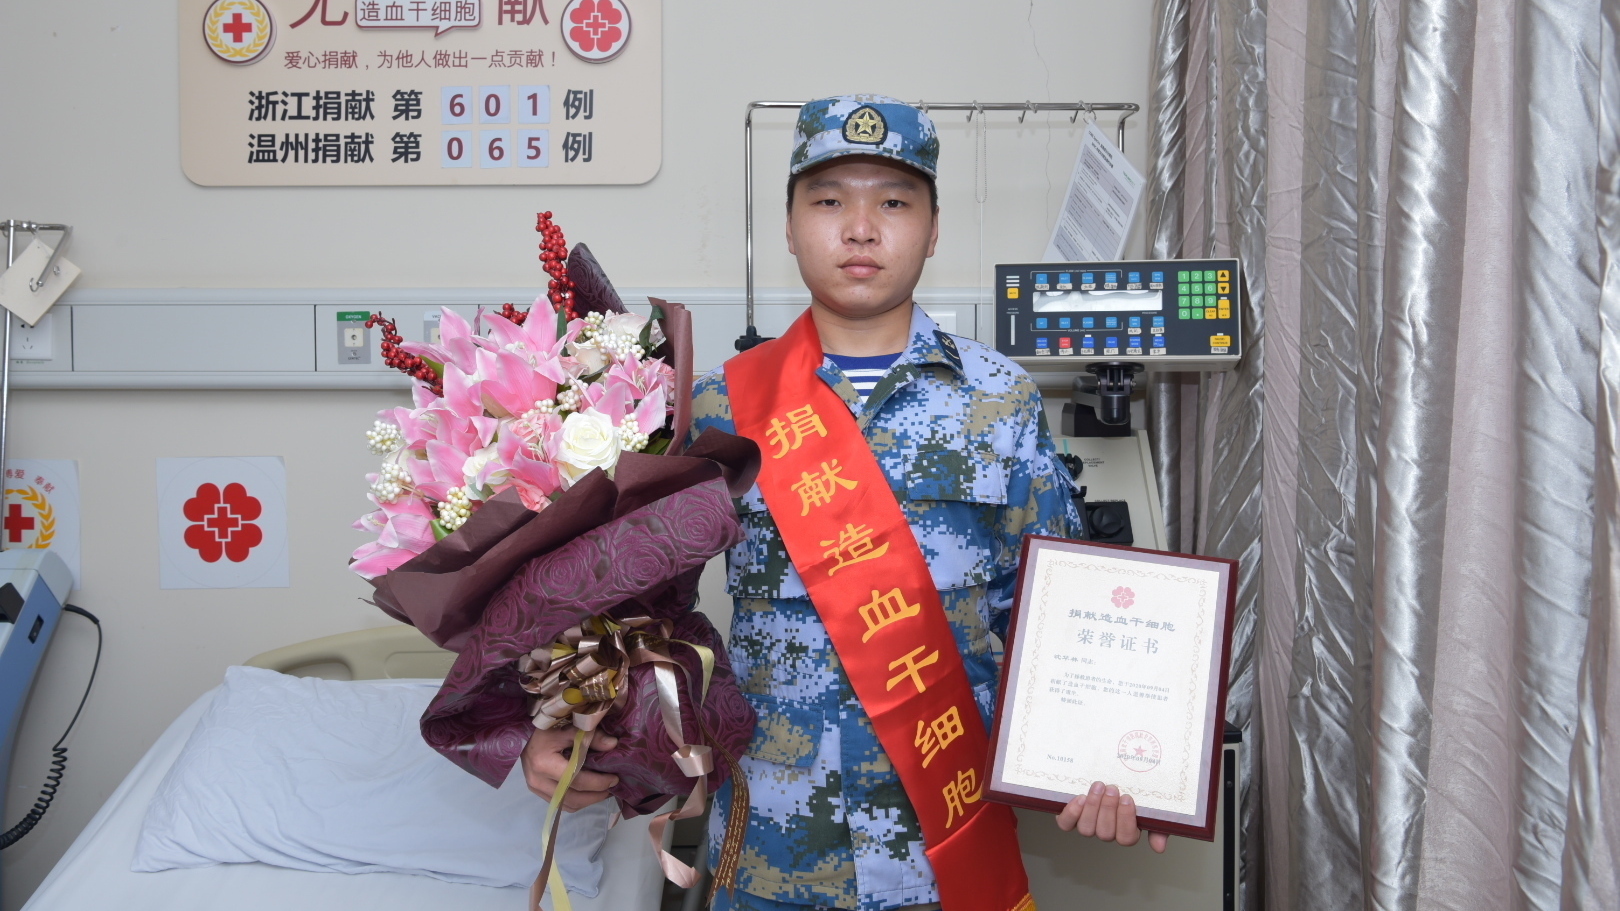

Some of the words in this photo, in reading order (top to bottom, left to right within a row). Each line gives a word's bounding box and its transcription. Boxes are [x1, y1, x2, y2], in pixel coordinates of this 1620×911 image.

[359, 0, 477, 23] 造血干细胞
[284, 49, 557, 70] 爱心捐献，为他人做出一点贡献！
[247, 89, 376, 122] 浙江捐献
[391, 89, 423, 121] 第
[448, 93, 540, 117] 601
[563, 89, 594, 121] 例
[247, 132, 375, 165] 温州捐献
[390, 131, 423, 164] 第
[446, 137, 542, 161] 065
[562, 131, 594, 164] 例
[765, 403, 984, 830] 捐献造血干细胞
[1068, 608, 1176, 632] 捐献造血干细胞
[1076, 628, 1159, 655] 荣誉证书
